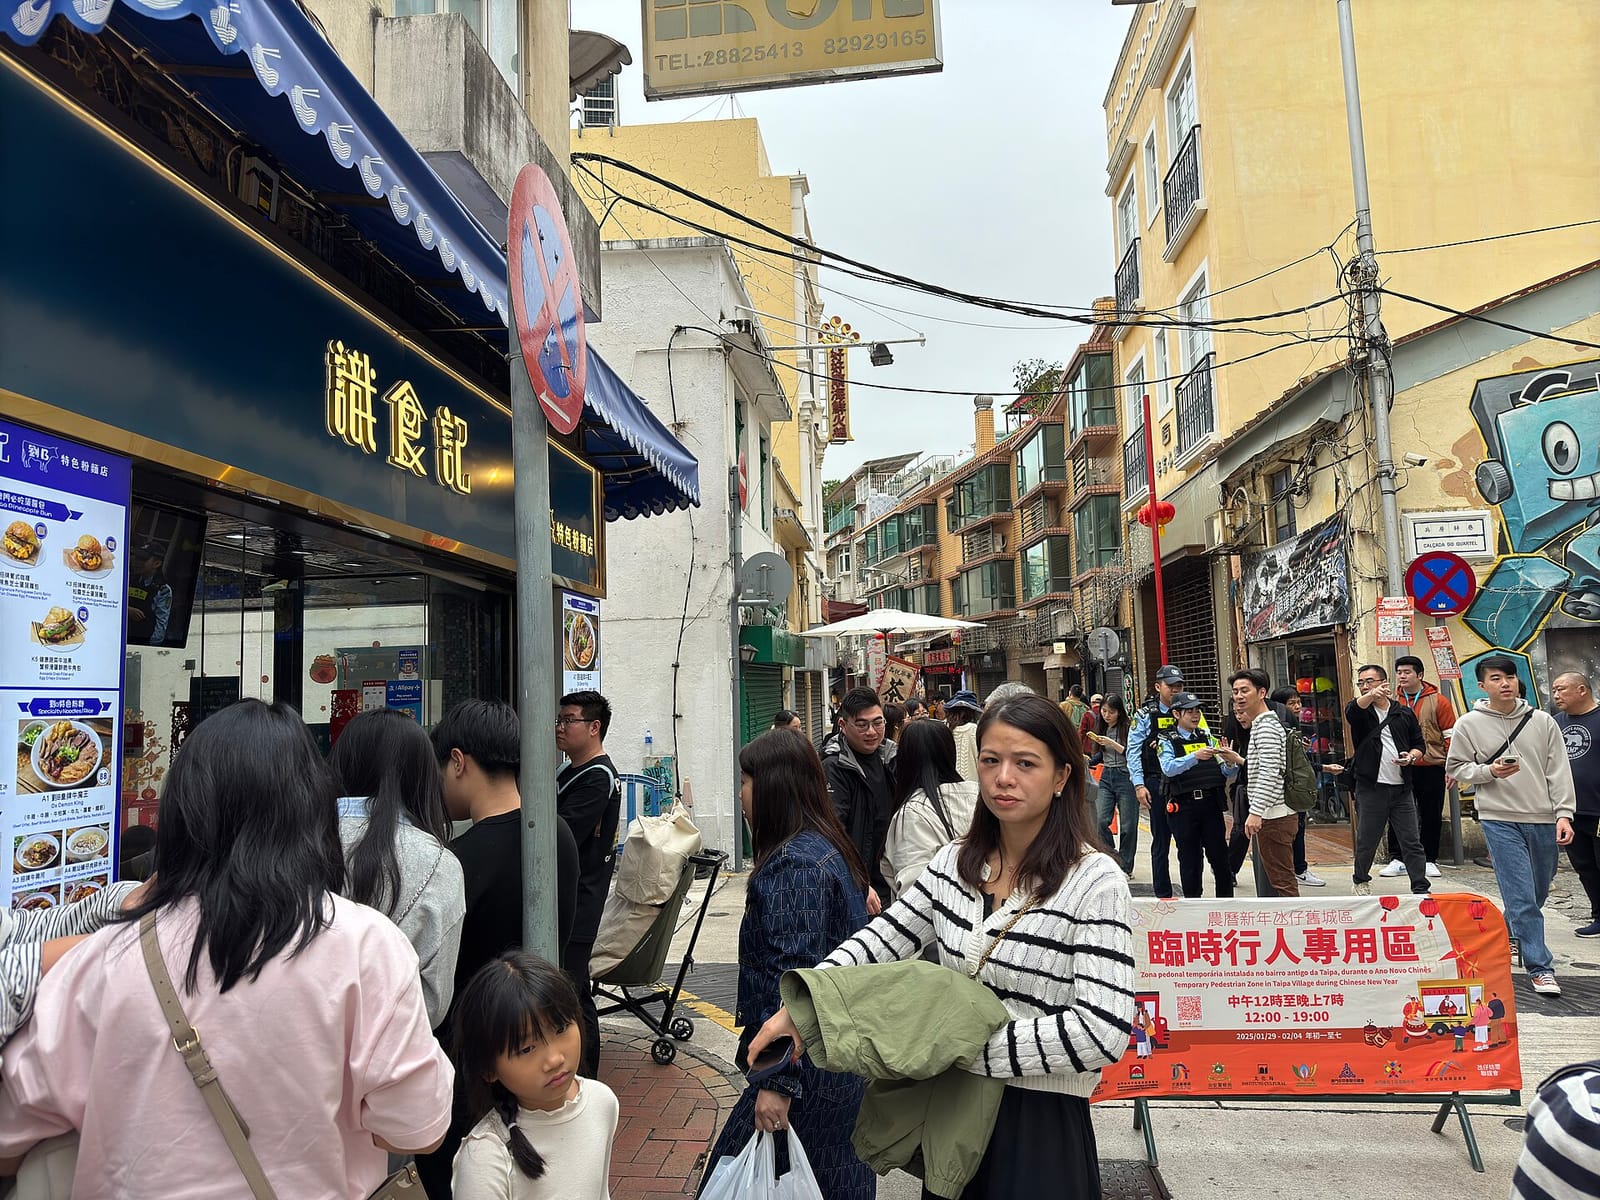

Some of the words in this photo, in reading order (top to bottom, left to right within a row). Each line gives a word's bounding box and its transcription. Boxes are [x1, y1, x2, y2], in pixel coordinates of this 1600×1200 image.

[655, 42, 804, 71] TEL:28825413
[823, 29, 927, 54] 82929165
[1423, 541, 1446, 549] CALÇADA
[1147, 925, 1420, 967] 臨時行人專用區
[1158, 970, 1185, 979] pedonal
[1186, 969, 1223, 979] temporária
[1223, 969, 1255, 977] instalada
[1265, 969, 1285, 977] bairro
[1287, 968, 1309, 978] antigo
[1320, 968, 1341, 978] Taipa,
[1341, 968, 1368, 976] durante
[1389, 967, 1407, 975] Novo
[1408, 965, 1432, 974] Chinês
[1173, 981, 1210, 990] Temporary
[1211, 980, 1246, 988] Pedestrian
[1272, 980, 1291, 989] Taipa
[1291, 979, 1315, 988] Village
[1315, 979, 1338, 988] during
[1228, 993, 1345, 1008] 中午12時至晚上7時
[1245, 1011, 1281, 1023] 12:00
[1293, 1011, 1330, 1023] 19:00
[1236, 1032, 1277, 1041] 2025/01/29
[1281, 1032, 1303, 1040] 02/04
[1305, 1032, 1342, 1040] 年初一至七
